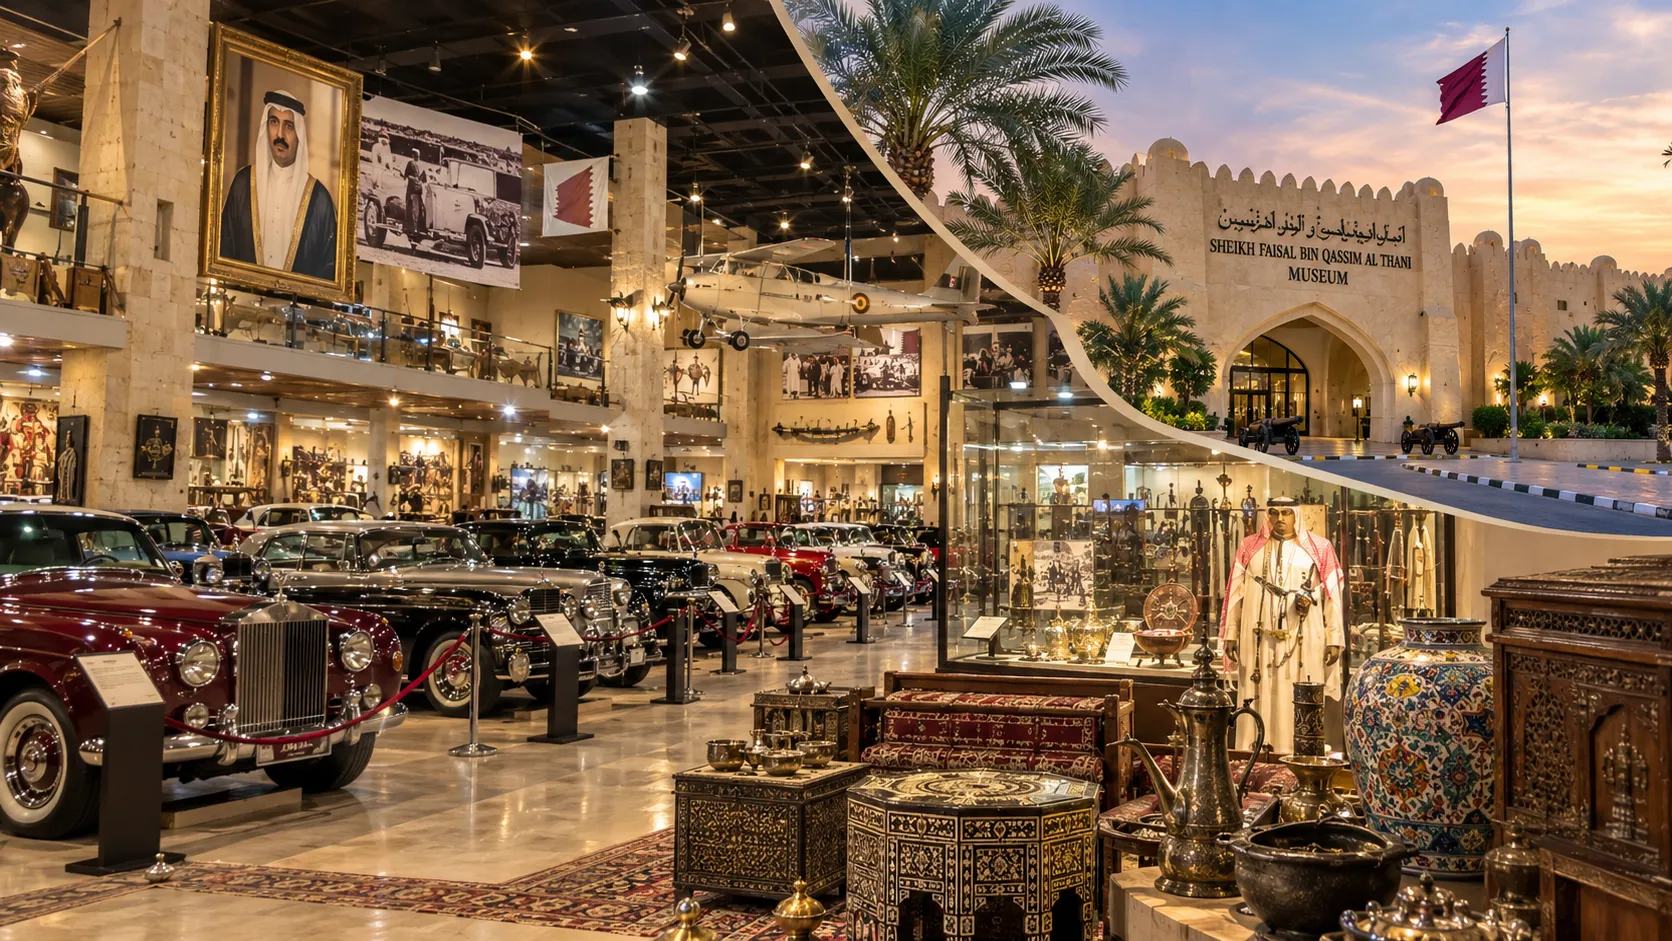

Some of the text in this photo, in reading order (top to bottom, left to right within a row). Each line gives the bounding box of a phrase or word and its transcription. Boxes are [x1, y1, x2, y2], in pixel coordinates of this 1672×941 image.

[1210, 238, 1412, 269] SHEIKH FAISAL BIN QASSIM AL THANI
[1288, 266, 1349, 286] MUSEUM
